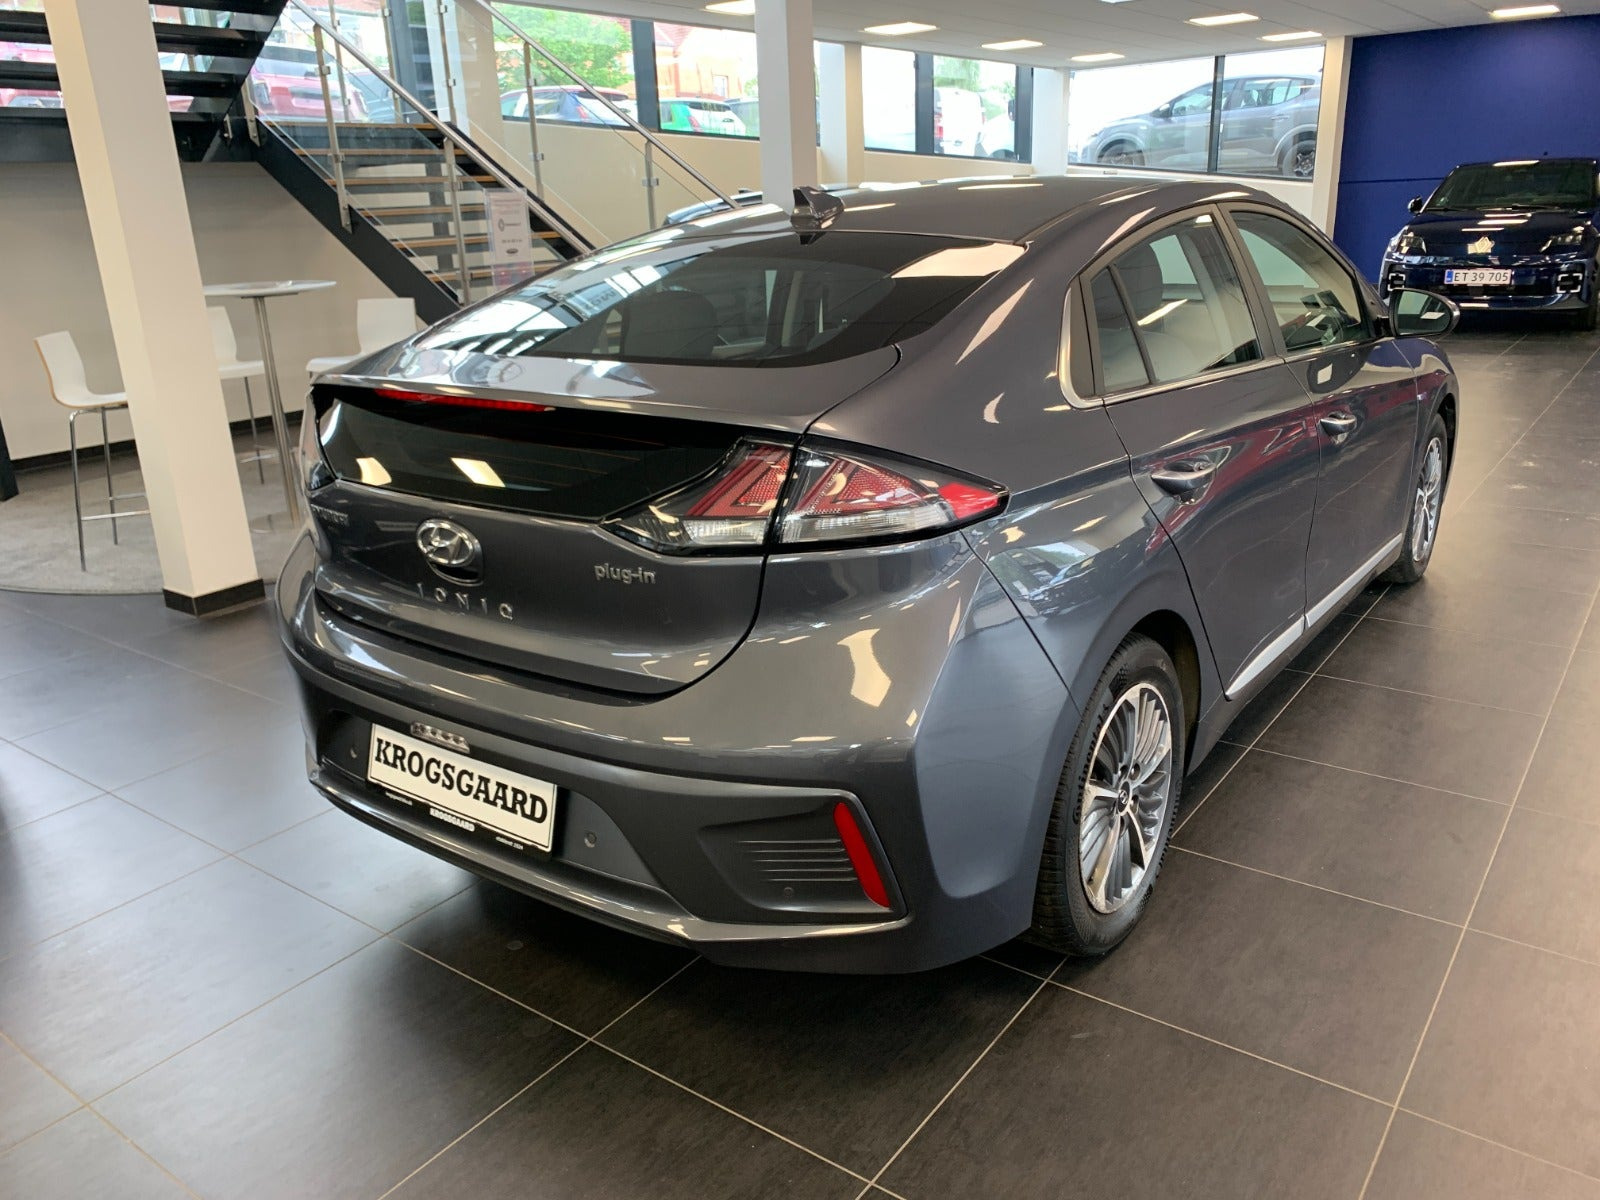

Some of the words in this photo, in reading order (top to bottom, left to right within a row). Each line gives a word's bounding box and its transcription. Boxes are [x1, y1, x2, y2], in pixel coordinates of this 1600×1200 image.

[1454, 272, 1469, 282] ET
[1471, 272, 1485, 282] 39
[1488, 272, 1509, 282] 705
[594, 562, 656, 584] plug-in
[416, 582, 513, 621] IONIQ
[375, 737, 548, 824] KROGSGAARD
[429, 807, 476, 832] KROGSGAARD
